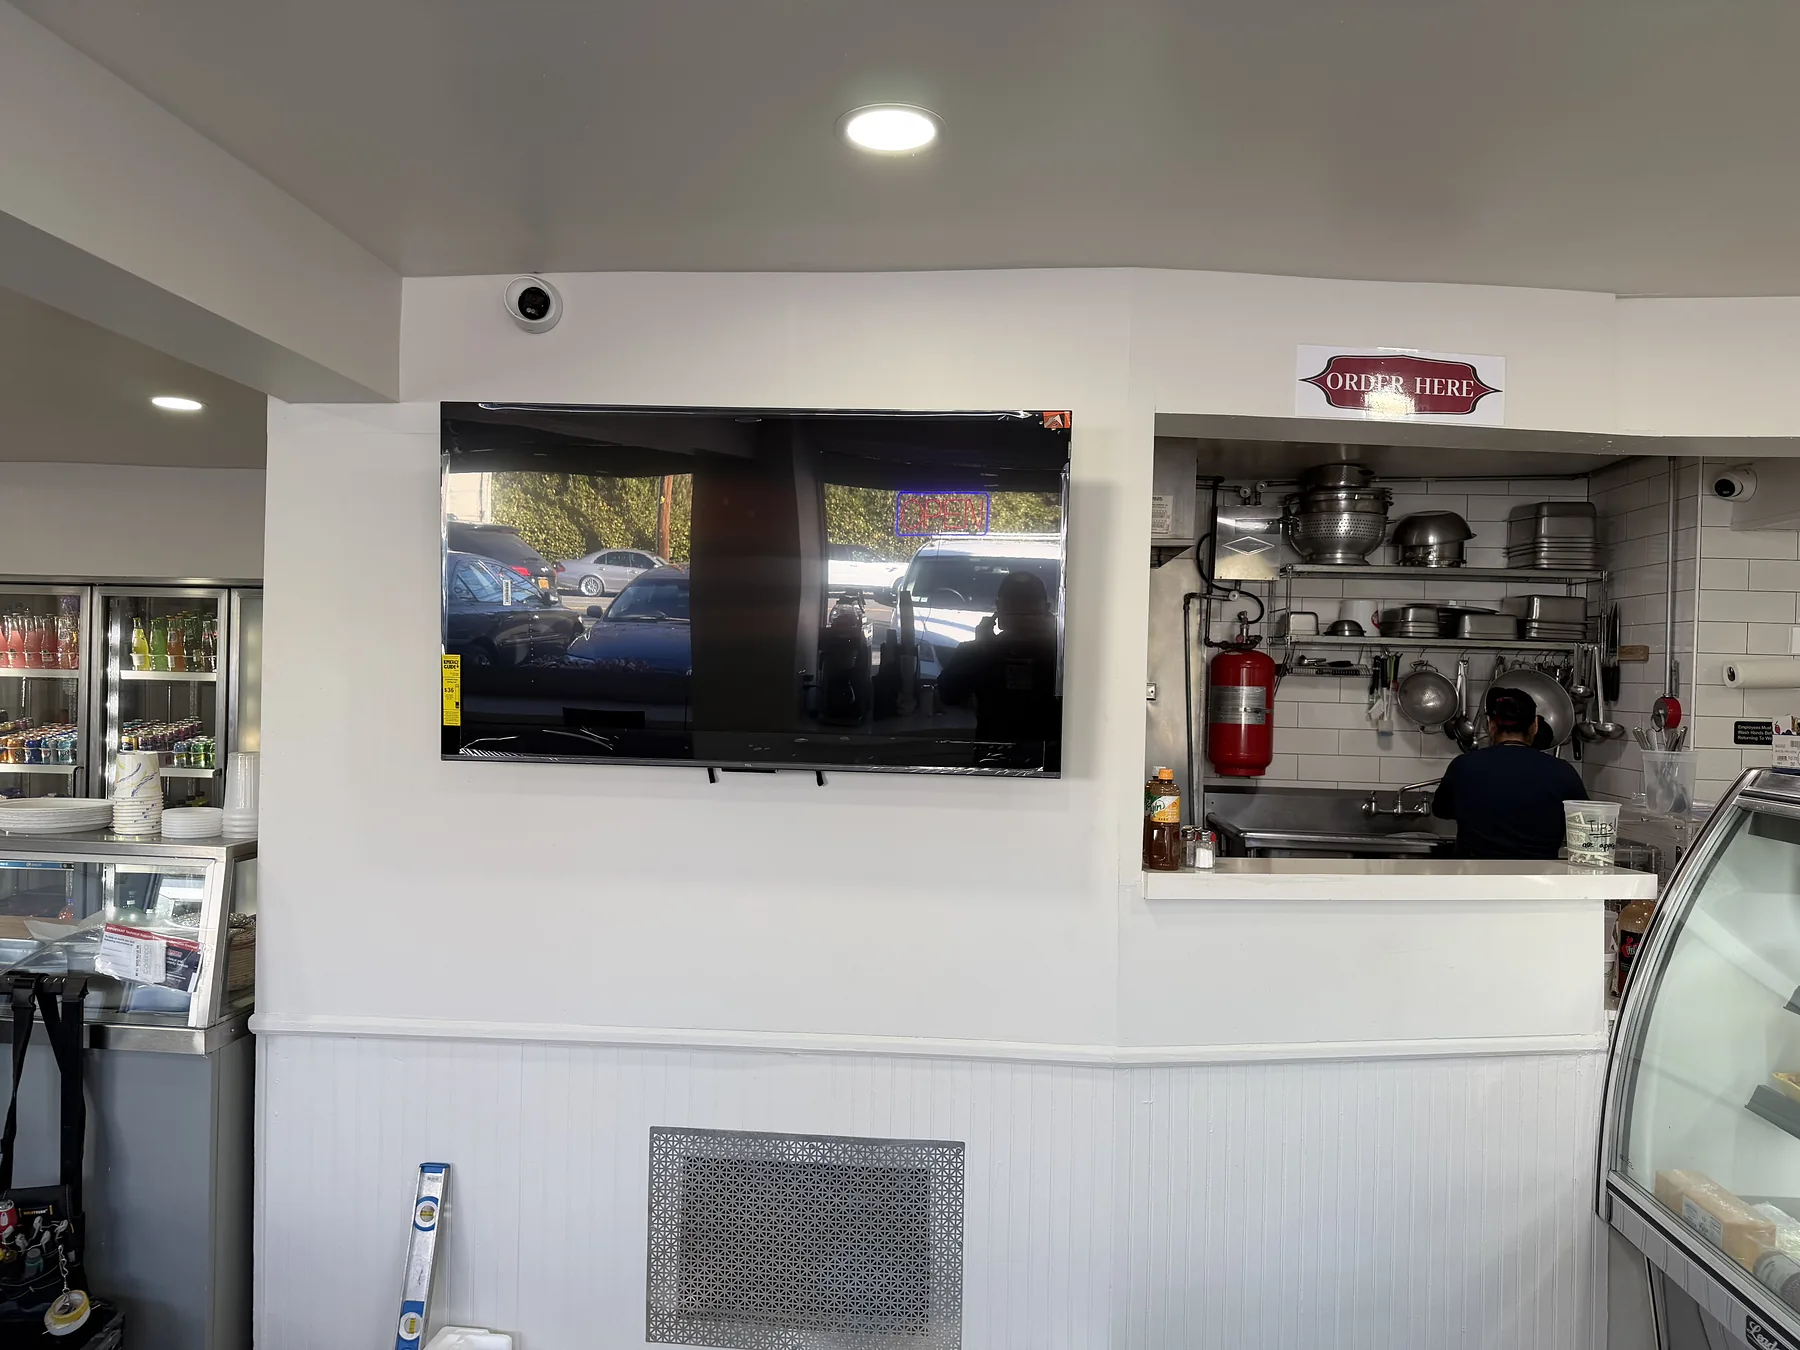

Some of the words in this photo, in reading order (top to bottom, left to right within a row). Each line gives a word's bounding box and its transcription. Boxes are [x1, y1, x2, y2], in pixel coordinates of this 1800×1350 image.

[1326, 372, 1404, 394] ORDER
[1414, 377, 1474, 398] HERE
[900, 498, 984, 531] OPEN
